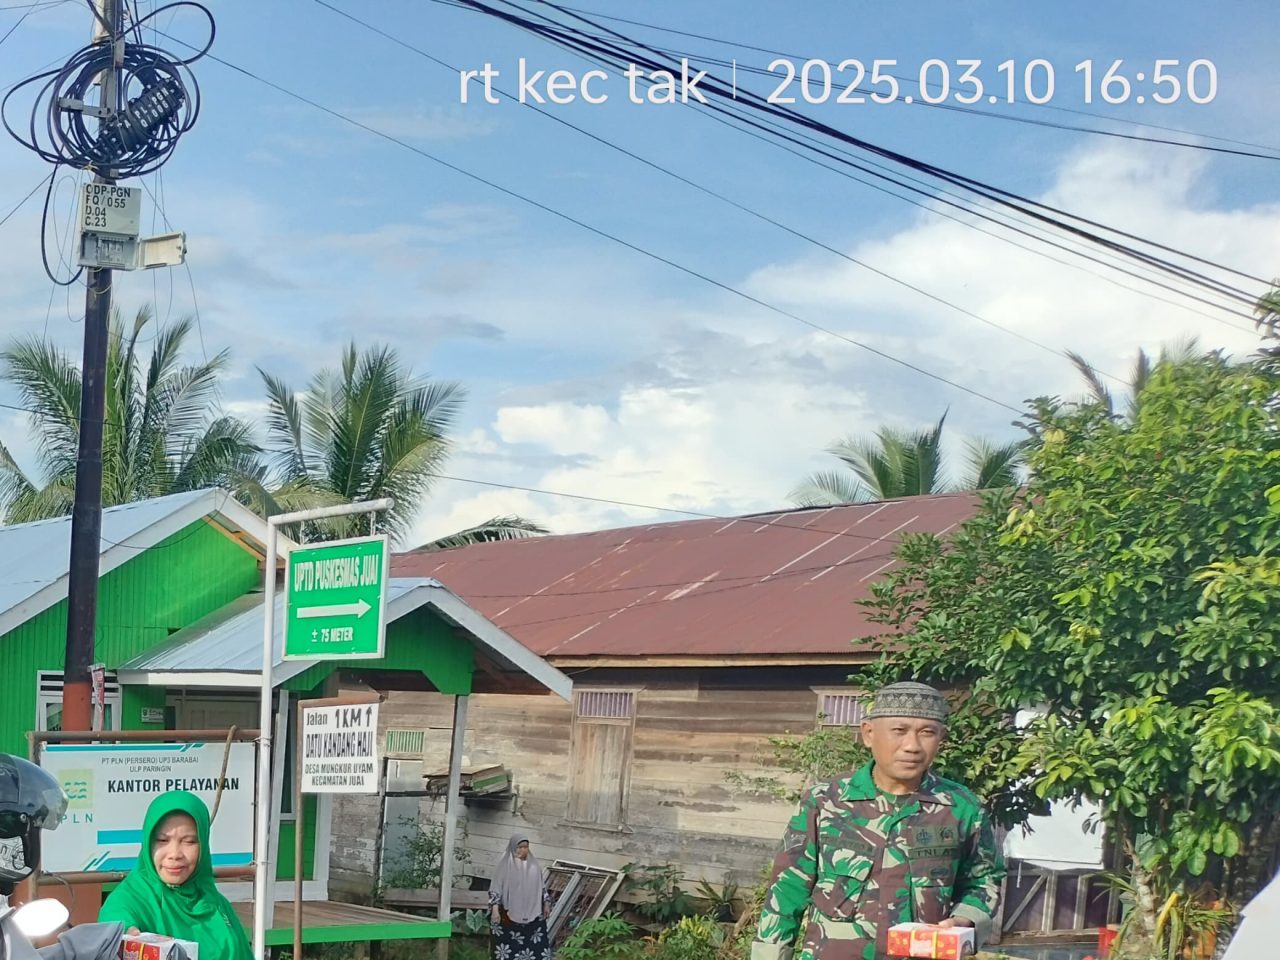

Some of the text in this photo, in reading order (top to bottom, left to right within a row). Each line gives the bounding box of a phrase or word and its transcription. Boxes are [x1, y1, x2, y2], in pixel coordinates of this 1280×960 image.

[85, 216, 106, 227] C.23
[294, 554, 379, 592] UPTD PUSKESMAS JUAI
[321, 628, 329, 642] 75
[330, 627, 353, 641] METER
[307, 712, 327, 725] Jalan
[306, 731, 373, 758] DATU KANDANG HAJI
[305, 763, 373, 774] DESA MUNGKUR UYAM
[108, 778, 239, 793] KANTOR PELAYANAN
[312, 776, 364, 786] KECAMATAN JUAI
